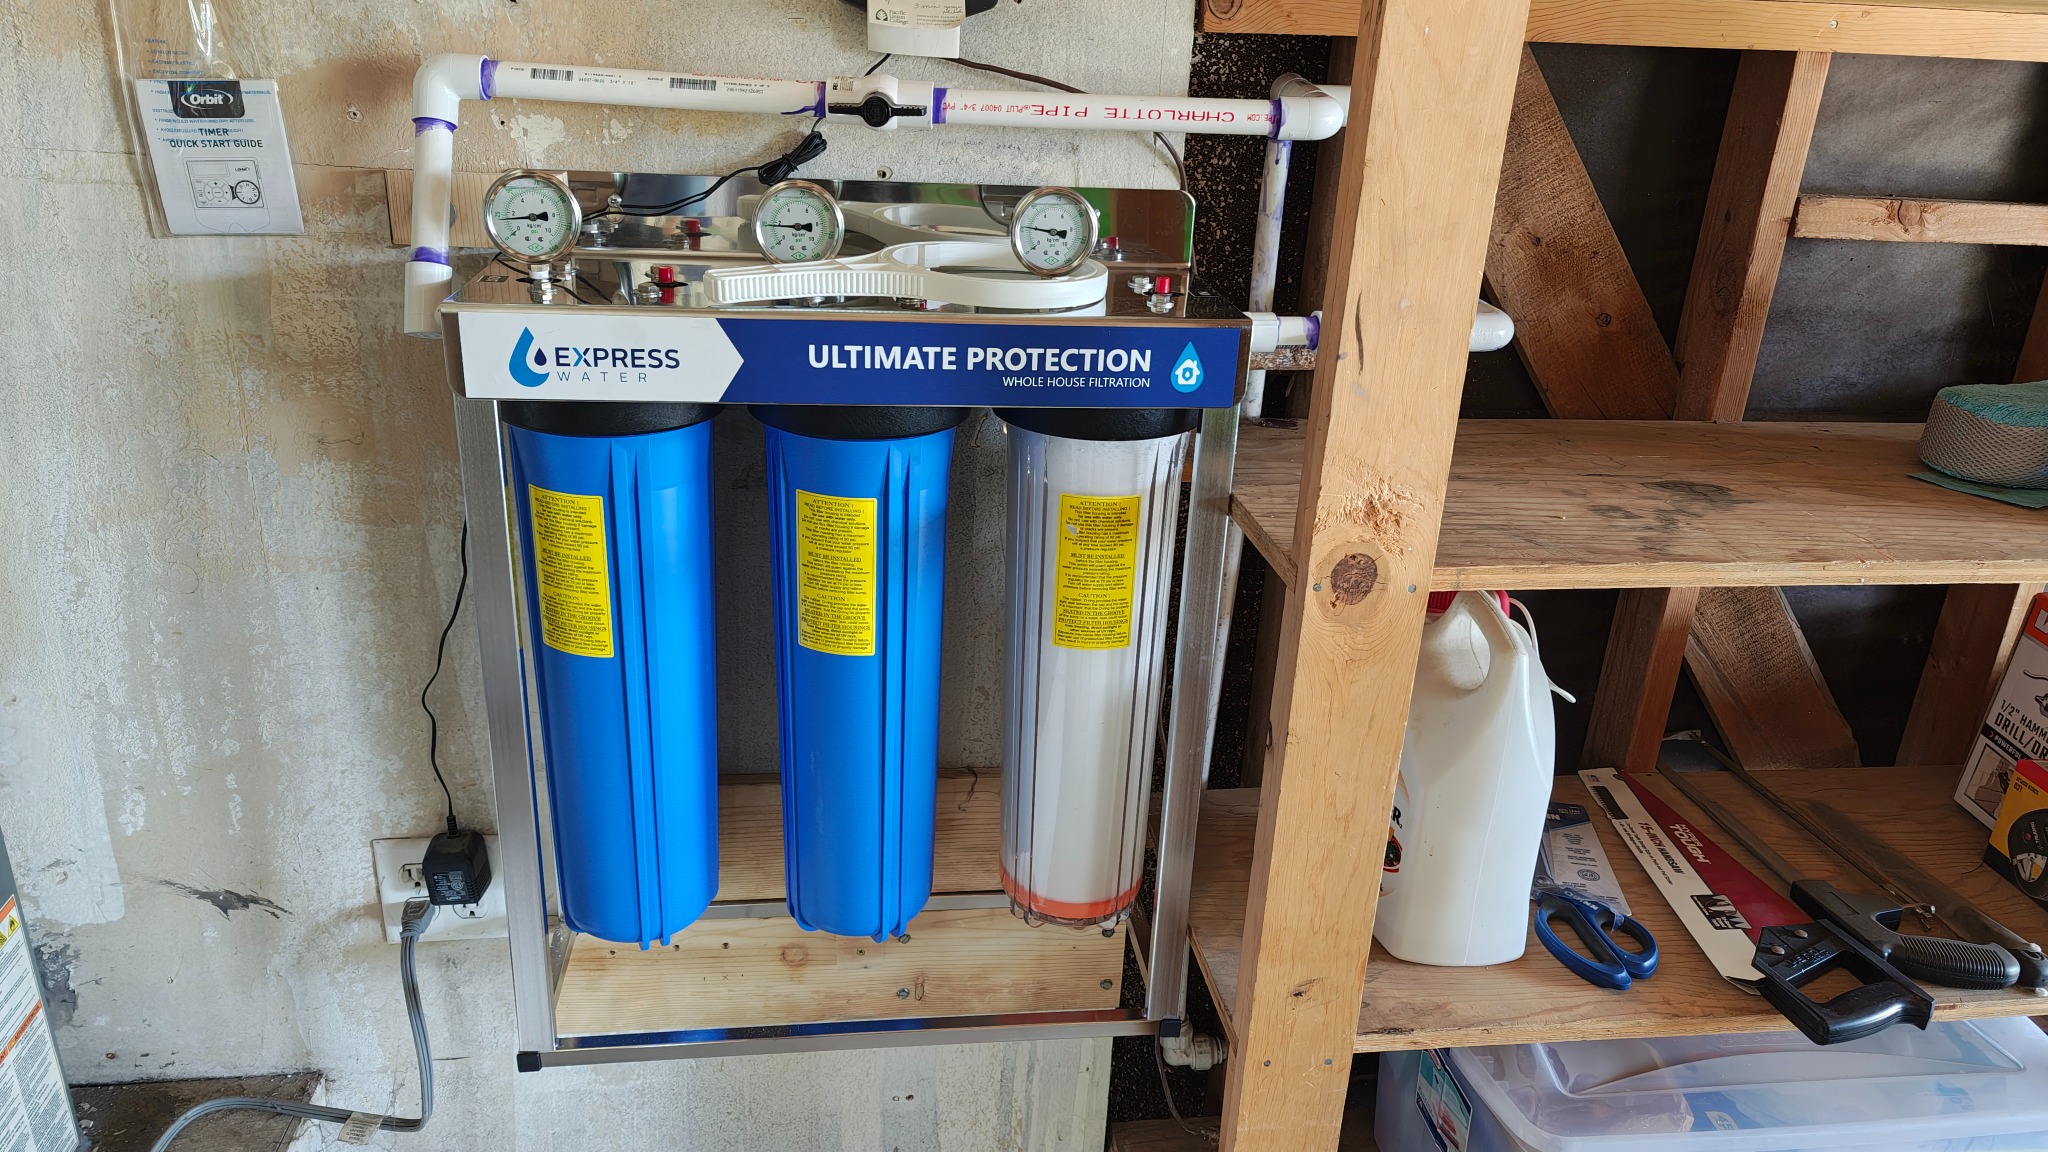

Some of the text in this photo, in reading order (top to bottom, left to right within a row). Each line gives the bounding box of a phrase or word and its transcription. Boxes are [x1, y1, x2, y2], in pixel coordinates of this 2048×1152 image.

[190, 93, 224, 105] Orbit
[980, 102, 1002, 113] 04007
[1104, 107, 1235, 123] CHARLOTTE
[200, 128, 229, 136] TIMER
[170, 140, 263, 148] QUICK START GUIDE
[555, 347, 680, 369] EXPRESS
[807, 344, 1152, 372] ULTIMATE PROTECTION
[556, 371, 647, 383] WATER
[1002, 376, 1150, 388] WHOLE HOUSE FILTRATION
[541, 495, 575, 504] ATTENTION
[813, 499, 850, 508] ATTENTION
[562, 553, 591, 561] INSTALLED
[553, 592, 579, 600] CAUTION
[817, 593, 845, 601] CAUTION
[2001, 699, 2020, 716] 1/2"
[1994, 736, 2022, 761] POWERFUL
[1682, 824, 1703, 847] HYPER
[1638, 822, 1685, 874] 15-INCH HANDSAW
[1669, 824, 1711, 865] TOUGH
